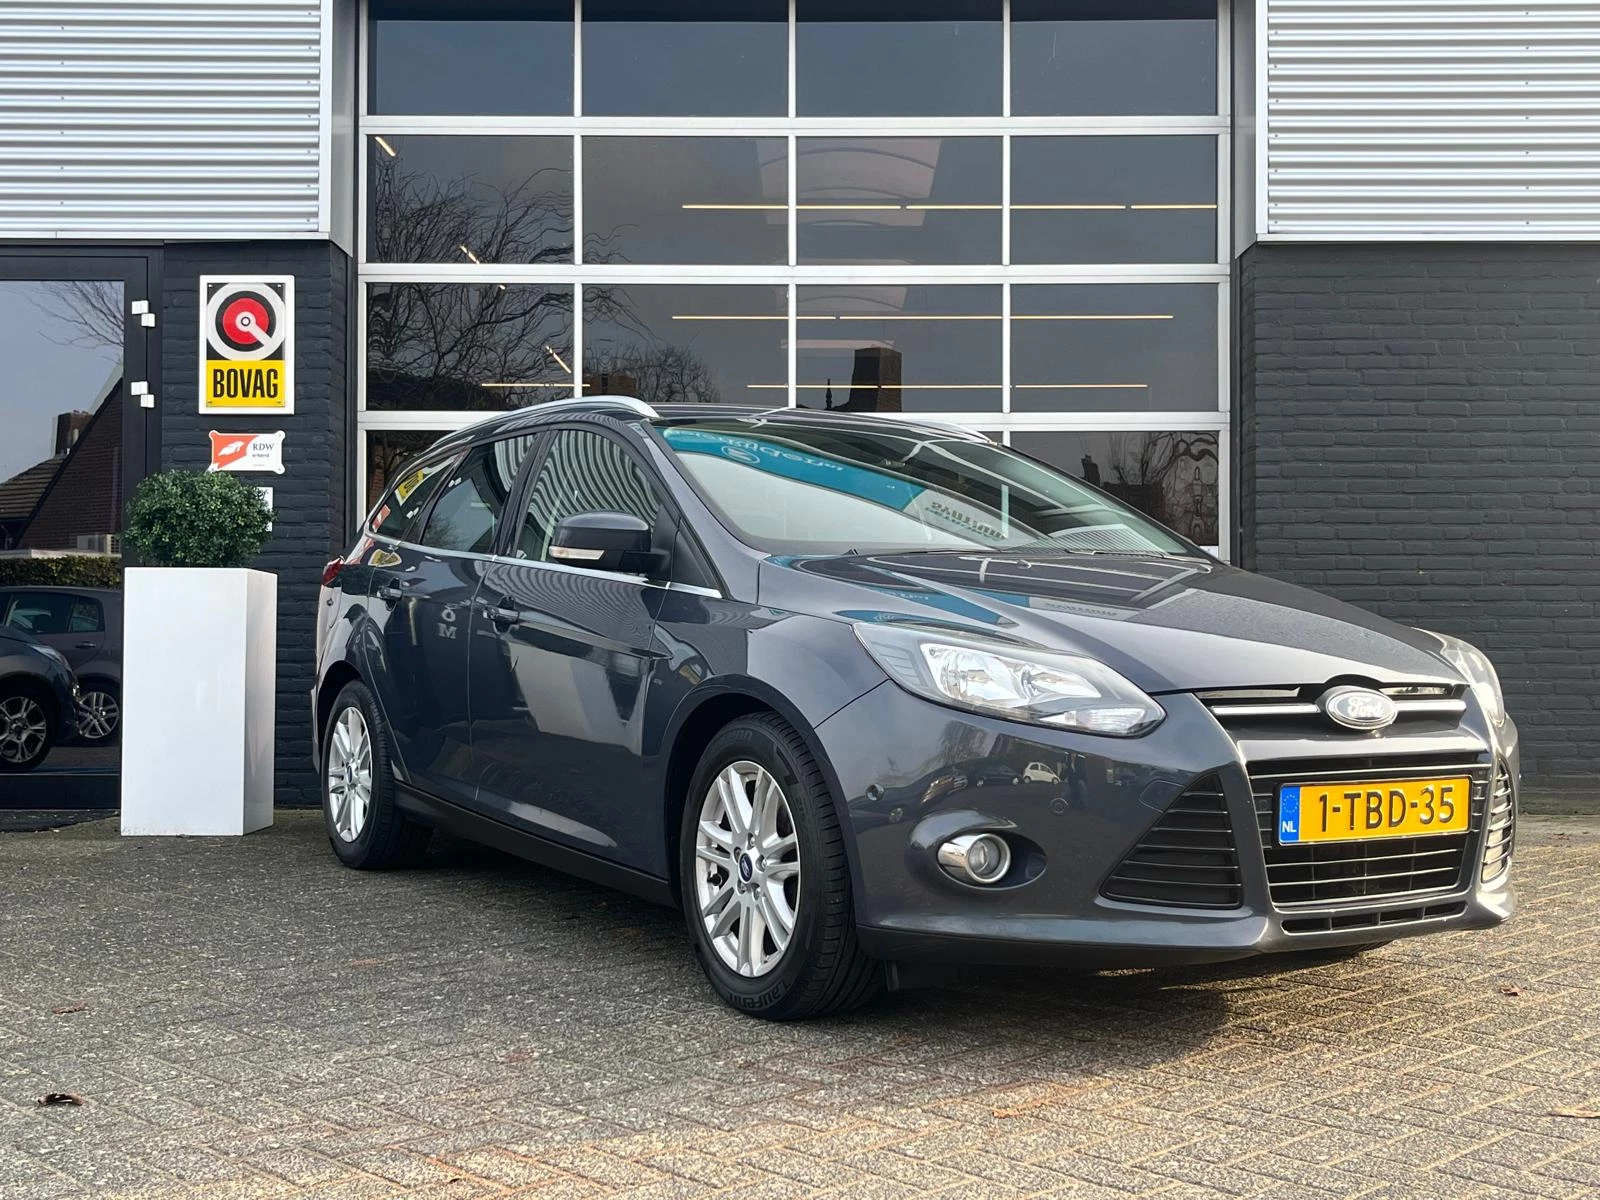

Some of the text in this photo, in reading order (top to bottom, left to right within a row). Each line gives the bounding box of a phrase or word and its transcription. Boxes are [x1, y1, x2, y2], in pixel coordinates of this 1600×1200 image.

[213, 368, 279, 399] BOVAG
[252, 442, 275, 451] RDW
[1318, 785, 1455, 832] 1-TBD-35
[1282, 820, 1297, 833] NL
